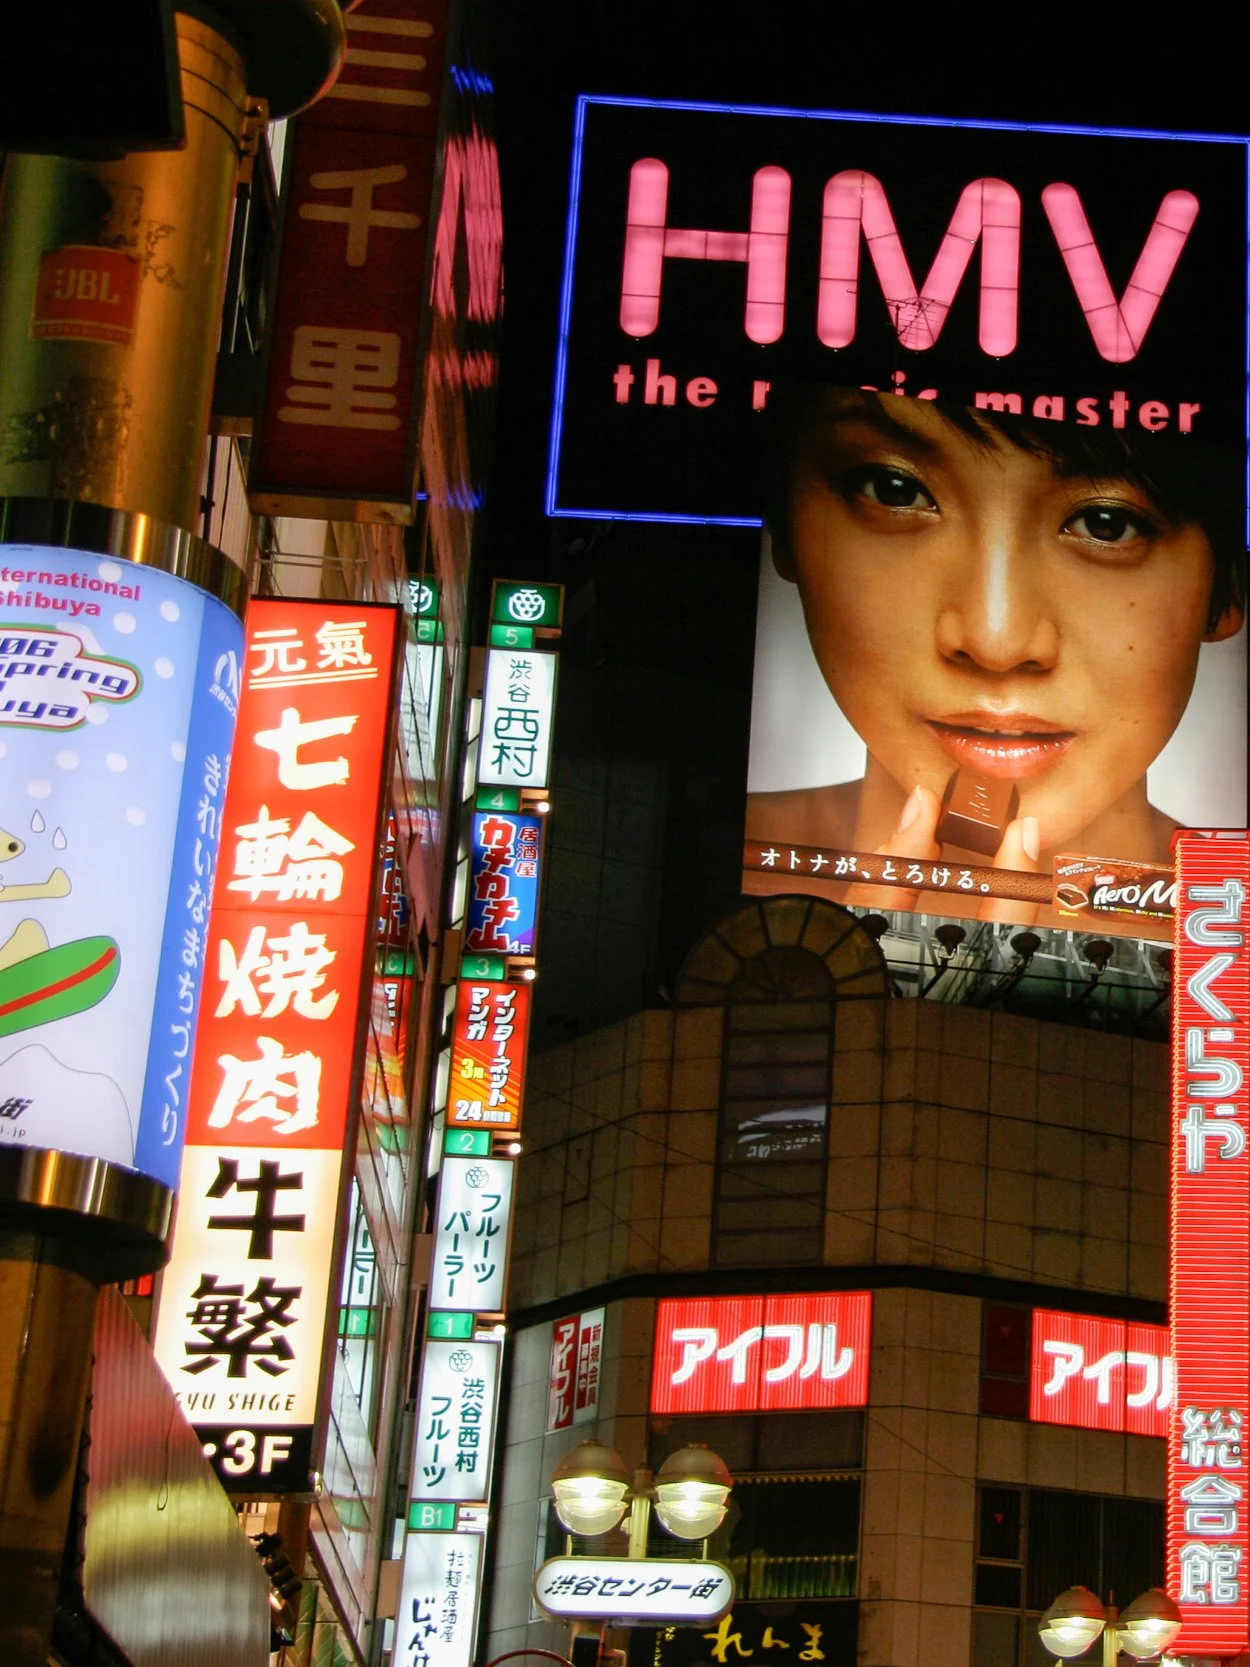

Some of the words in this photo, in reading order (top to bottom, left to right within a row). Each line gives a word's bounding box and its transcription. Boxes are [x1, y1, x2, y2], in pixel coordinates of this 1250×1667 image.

[54, 268, 120, 305] JBL
[619, 157, 1200, 363] HMV
[613, 358, 718, 407] the
[505, 629, 519, 645] 5
[491, 658, 539, 777] 渋谷西村
[490, 792, 504, 809] 4
[515, 827, 539, 878] 居酒屋
[760, 847, 991, 893] オトナが、とろける。
[475, 957, 490, 976] 3
[509, 940, 531, 954] 4F
[466, 986, 490, 1041] マンガ
[1181, 878, 1246, 1174] さくらや
[488, 989, 517, 1107] インターネット
[460, 1133, 475, 1152] 2
[444, 1210, 472, 1297] パーラー
[474, 1194, 502, 1283] フルーツ
[180, 1157, 305, 1378] 牛繁
[445, 1316, 453, 1334] 1
[552, 1322, 575, 1425] アイフル
[671, 1322, 855, 1386] アイフル
[228, 1392, 297, 1412] SHIGE
[455, 1378, 485, 1473] 渋谷西村
[423, 1396, 452, 1487] フルーツ
[421, 1507, 443, 1527] B1
[1179, 1406, 1243, 1604] 総合館
[544, 1574, 724, 1600] 渋谷センター街
